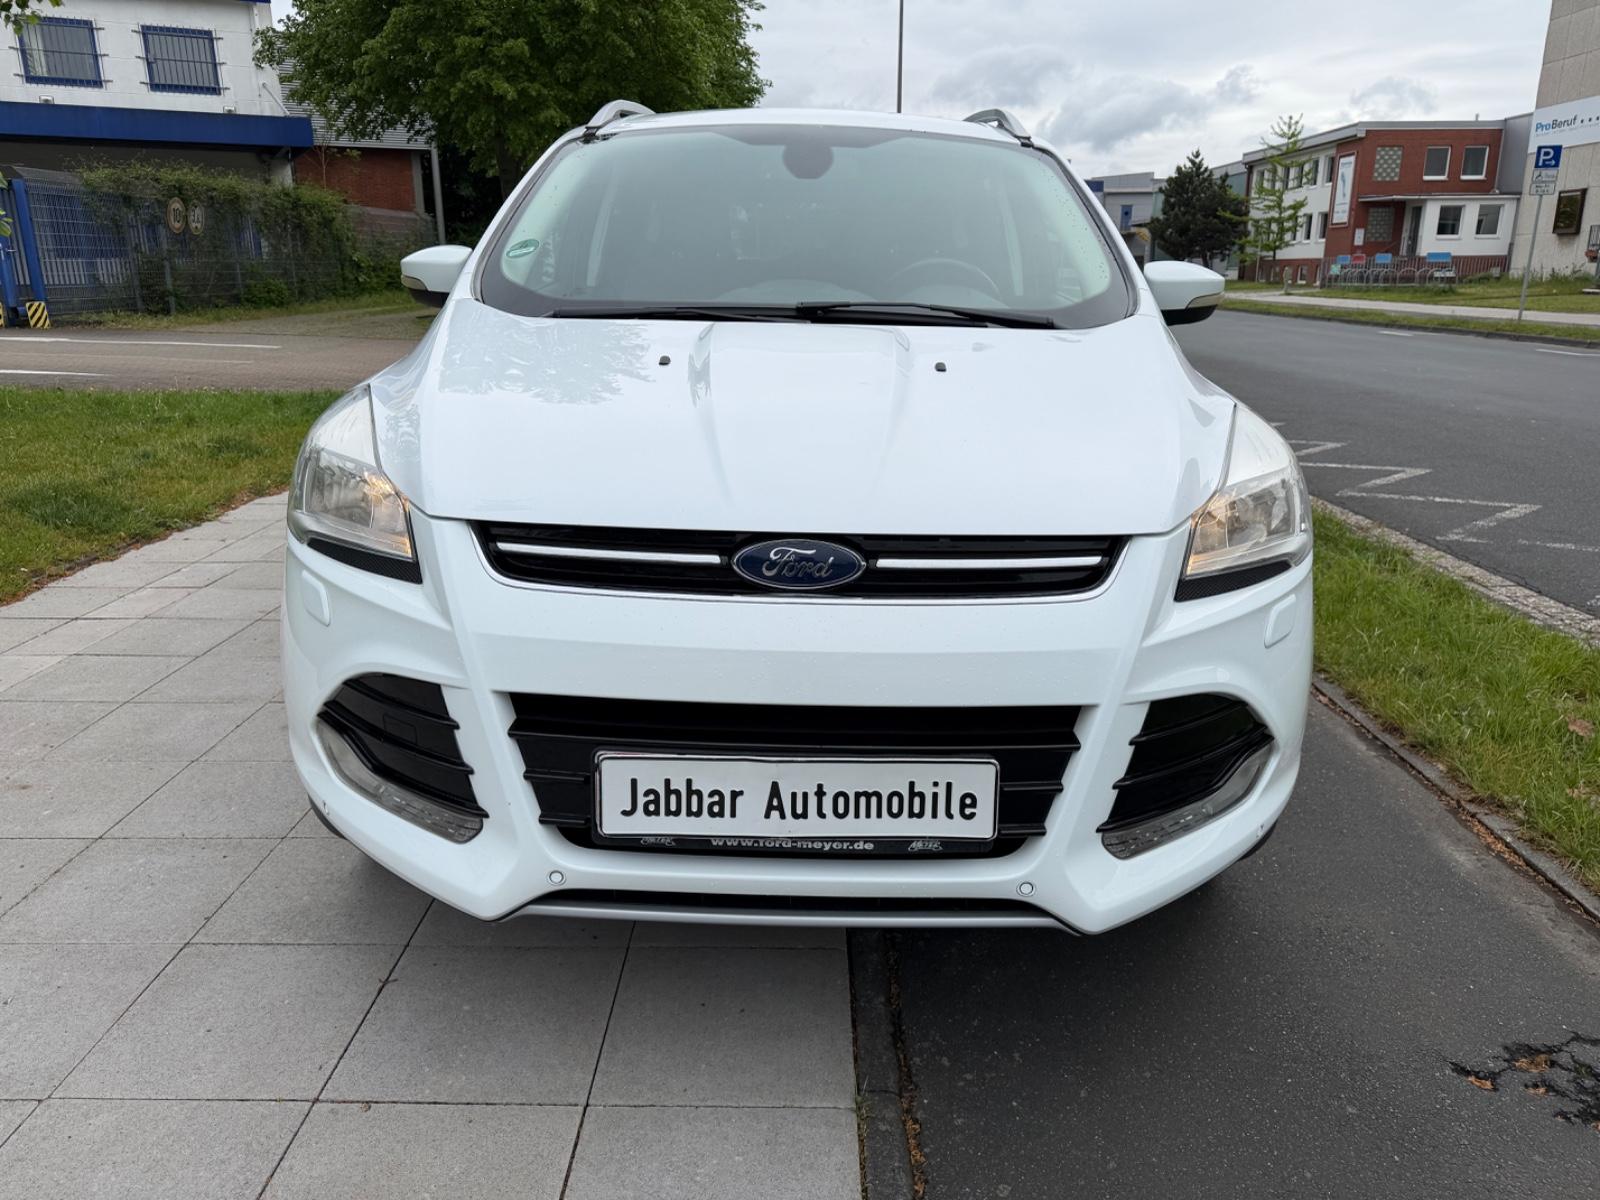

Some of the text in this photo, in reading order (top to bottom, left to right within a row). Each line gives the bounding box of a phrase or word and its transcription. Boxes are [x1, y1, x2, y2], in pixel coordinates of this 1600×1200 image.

[1538, 148, 1554, 166] P
[762, 546, 834, 578] Ford
[620, 778, 978, 821] Jabbar Automobile
